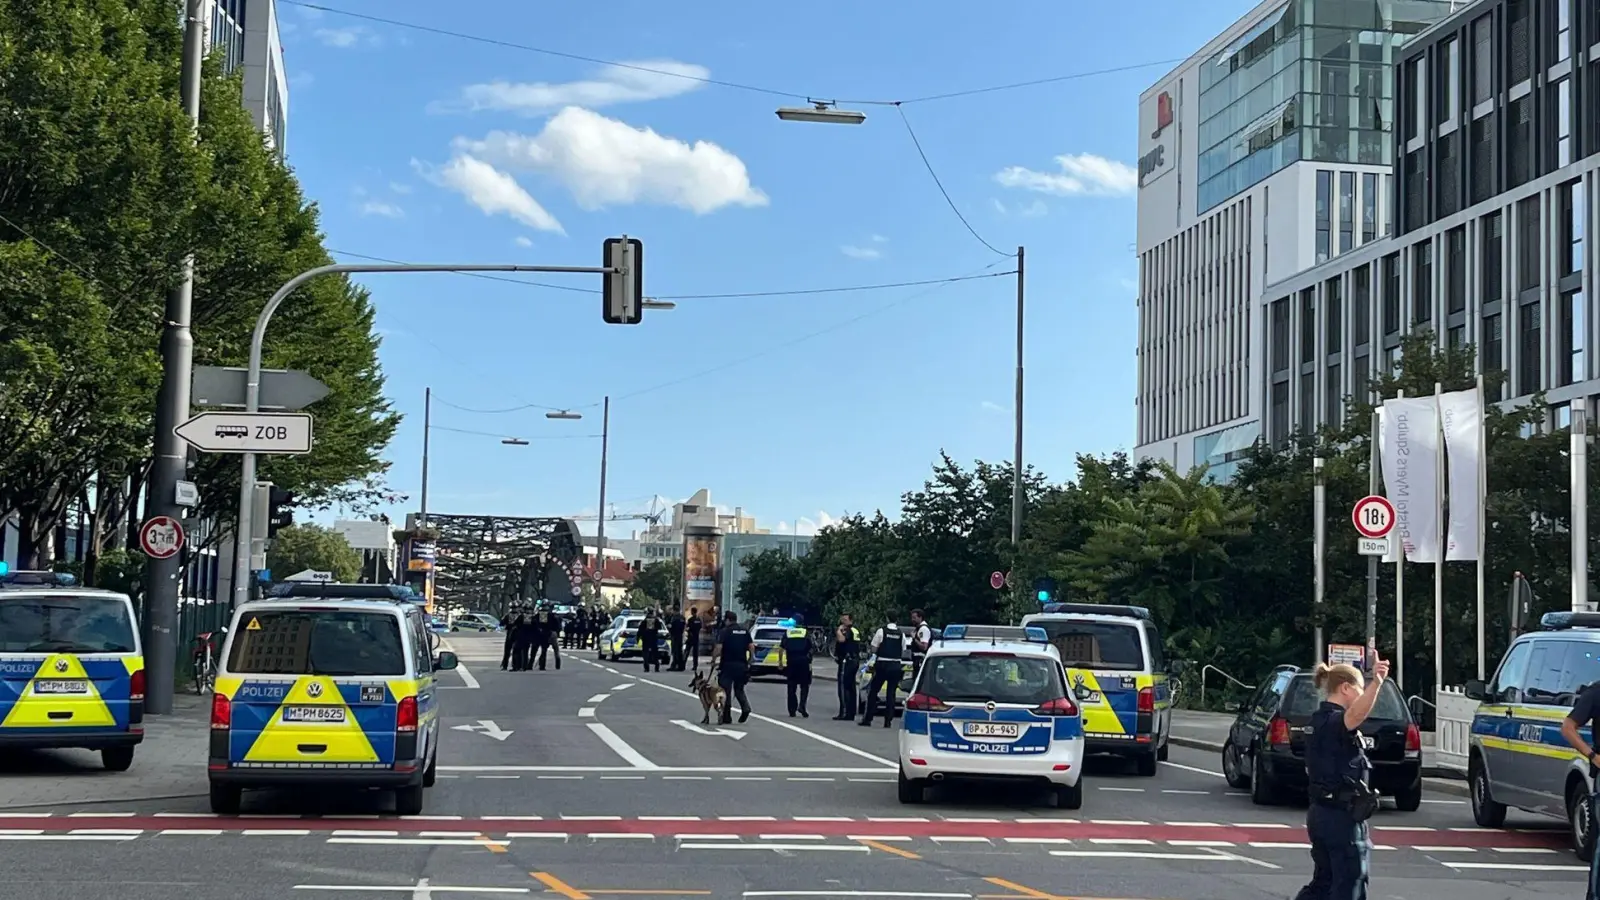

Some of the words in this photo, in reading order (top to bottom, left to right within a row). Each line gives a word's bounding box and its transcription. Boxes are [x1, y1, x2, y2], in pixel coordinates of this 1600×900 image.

[255, 426, 288, 440] ZOB
[0, 664, 35, 673] POLIZEI
[242, 686, 284, 697] POLIZEI
[317, 708, 343, 719] 8625
[1519, 723, 1543, 742] POLIZEI
[972, 743, 1010, 753] POLIZEI
